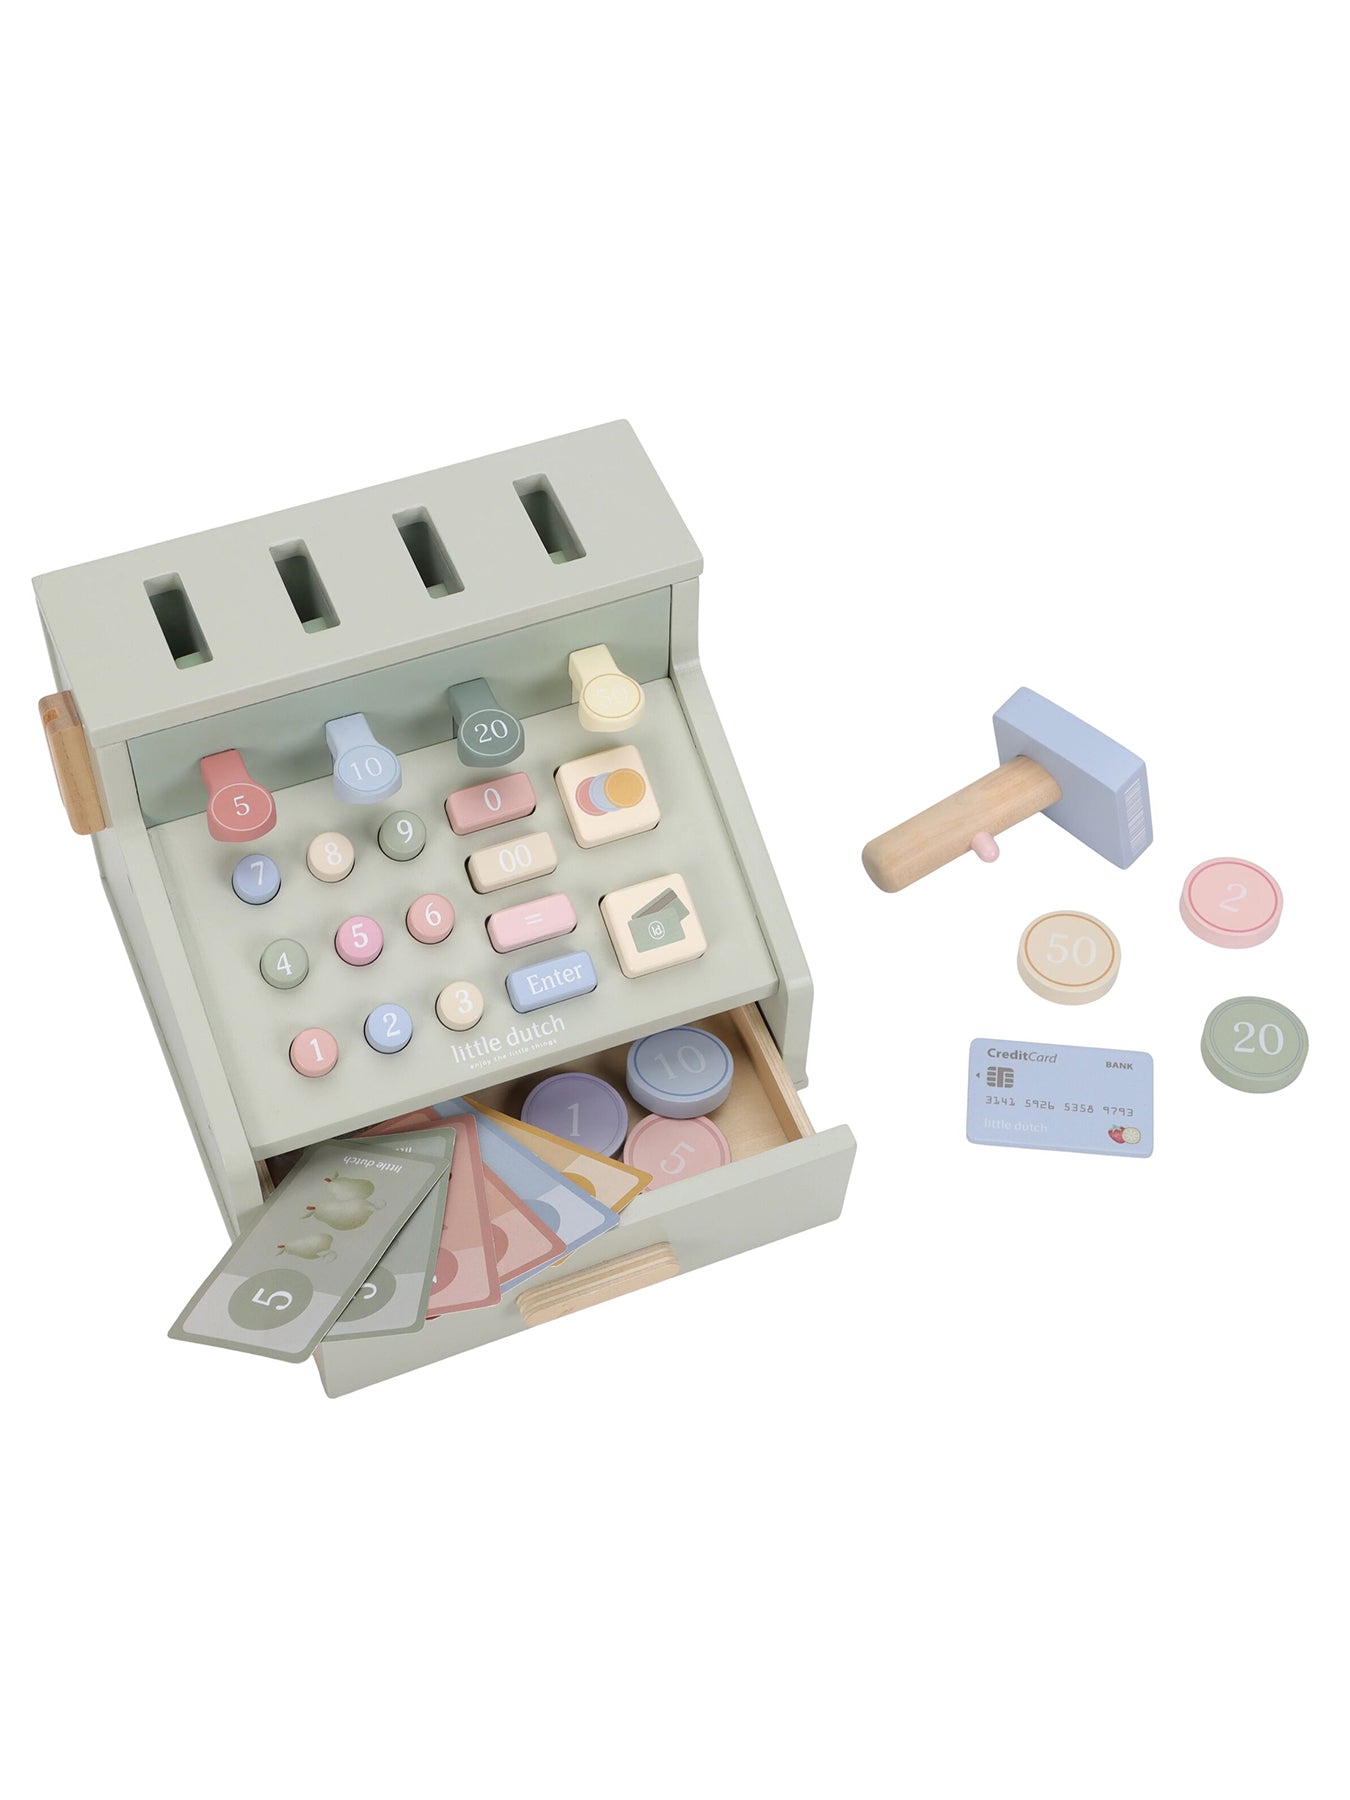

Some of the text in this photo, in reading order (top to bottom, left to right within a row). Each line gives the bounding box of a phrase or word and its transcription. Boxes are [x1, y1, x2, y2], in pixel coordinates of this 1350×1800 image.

[474, 719, 508, 744] 20
[349, 757, 382, 781] 10
[233, 795, 250, 816] 5
[396, 820, 413, 844] 9
[324, 842, 342, 866] 8
[250, 861, 265, 885] 7
[1219, 883, 1247, 912] 2
[424, 902, 441, 927] 6
[351, 923, 369, 948] 5
[1046, 934, 1097, 966] 50
[275, 951, 292, 976] 4
[526, 961, 583, 995] Enter
[455, 989, 473, 1013] 3
[382, 1012, 399, 1037] 2
[309, 1037, 324, 1062] 1
[450, 1014, 565, 1063] little dutch
[1233, 1021, 1284, 1055] 20
[494, 1054, 507, 1062] the
[509, 1047, 529, 1057] little
[654, 1045, 706, 1081] 10
[987, 1047, 1058, 1064] CreditCard
[1105, 1060, 1134, 1070] BANK
[985, 1095, 1134, 1117] 3141 5926 5358 9793
[567, 1102, 581, 1137] 1
[983, 1117, 1048, 1134] little dutch
[343, 1155, 402, 1174] little dutch
[660, 1141, 696, 1175] 5
[251, 1287, 293, 1311] 5
